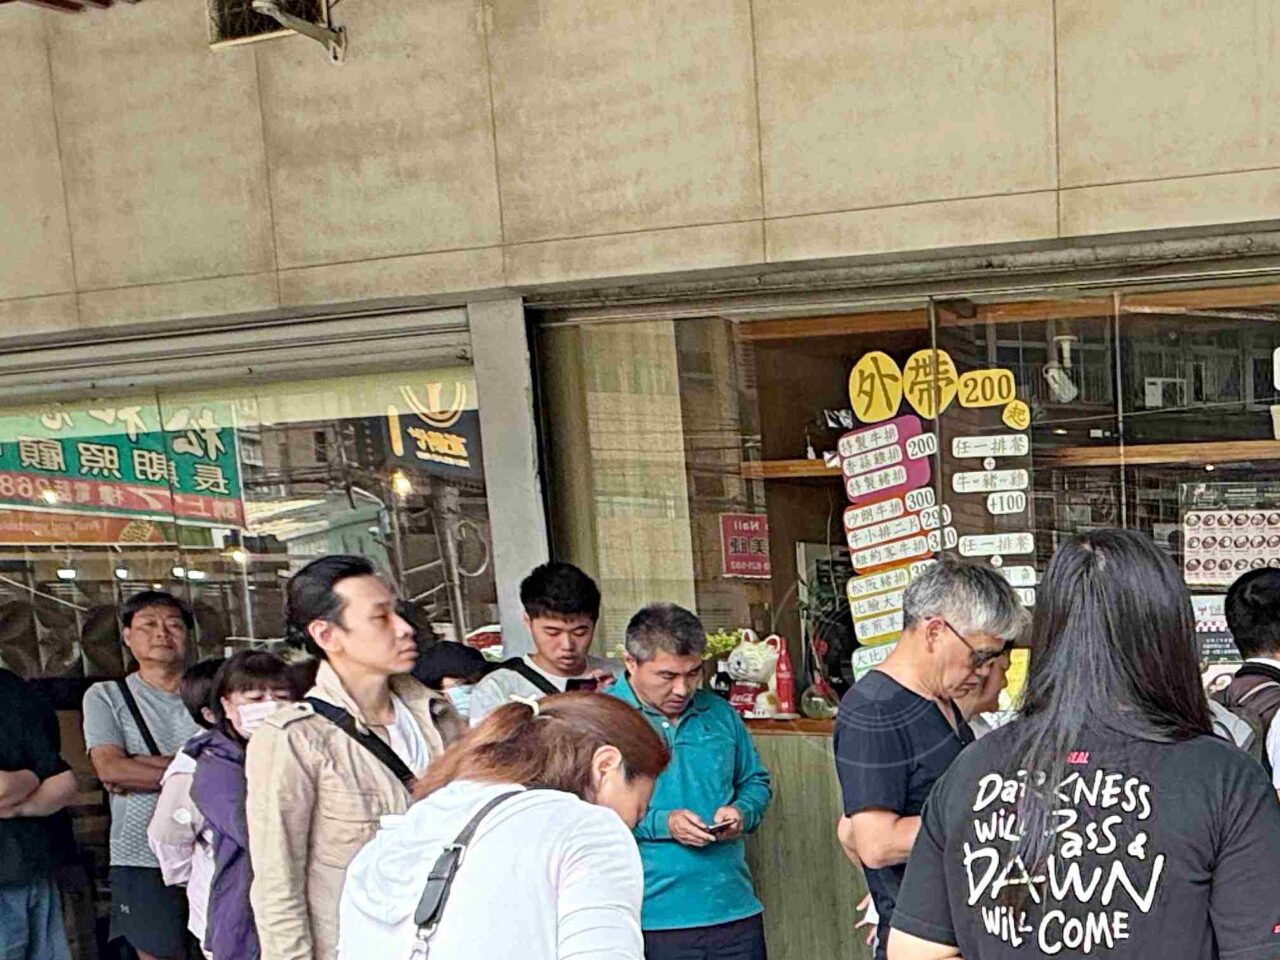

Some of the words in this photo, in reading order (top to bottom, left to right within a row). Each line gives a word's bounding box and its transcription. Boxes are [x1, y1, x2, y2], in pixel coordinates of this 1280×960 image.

[857, 354, 955, 417] 外帶
[963, 374, 1012, 403] 200
[1008, 403, 1027, 426] 起
[908, 435, 936, 457] 200
[907, 490, 933, 509] 300
[929, 531, 956, 552] 30
[1127, 832, 1148, 860] &
[963, 842, 1165, 913] DAWN
[1037, 909, 1130, 955] COME
